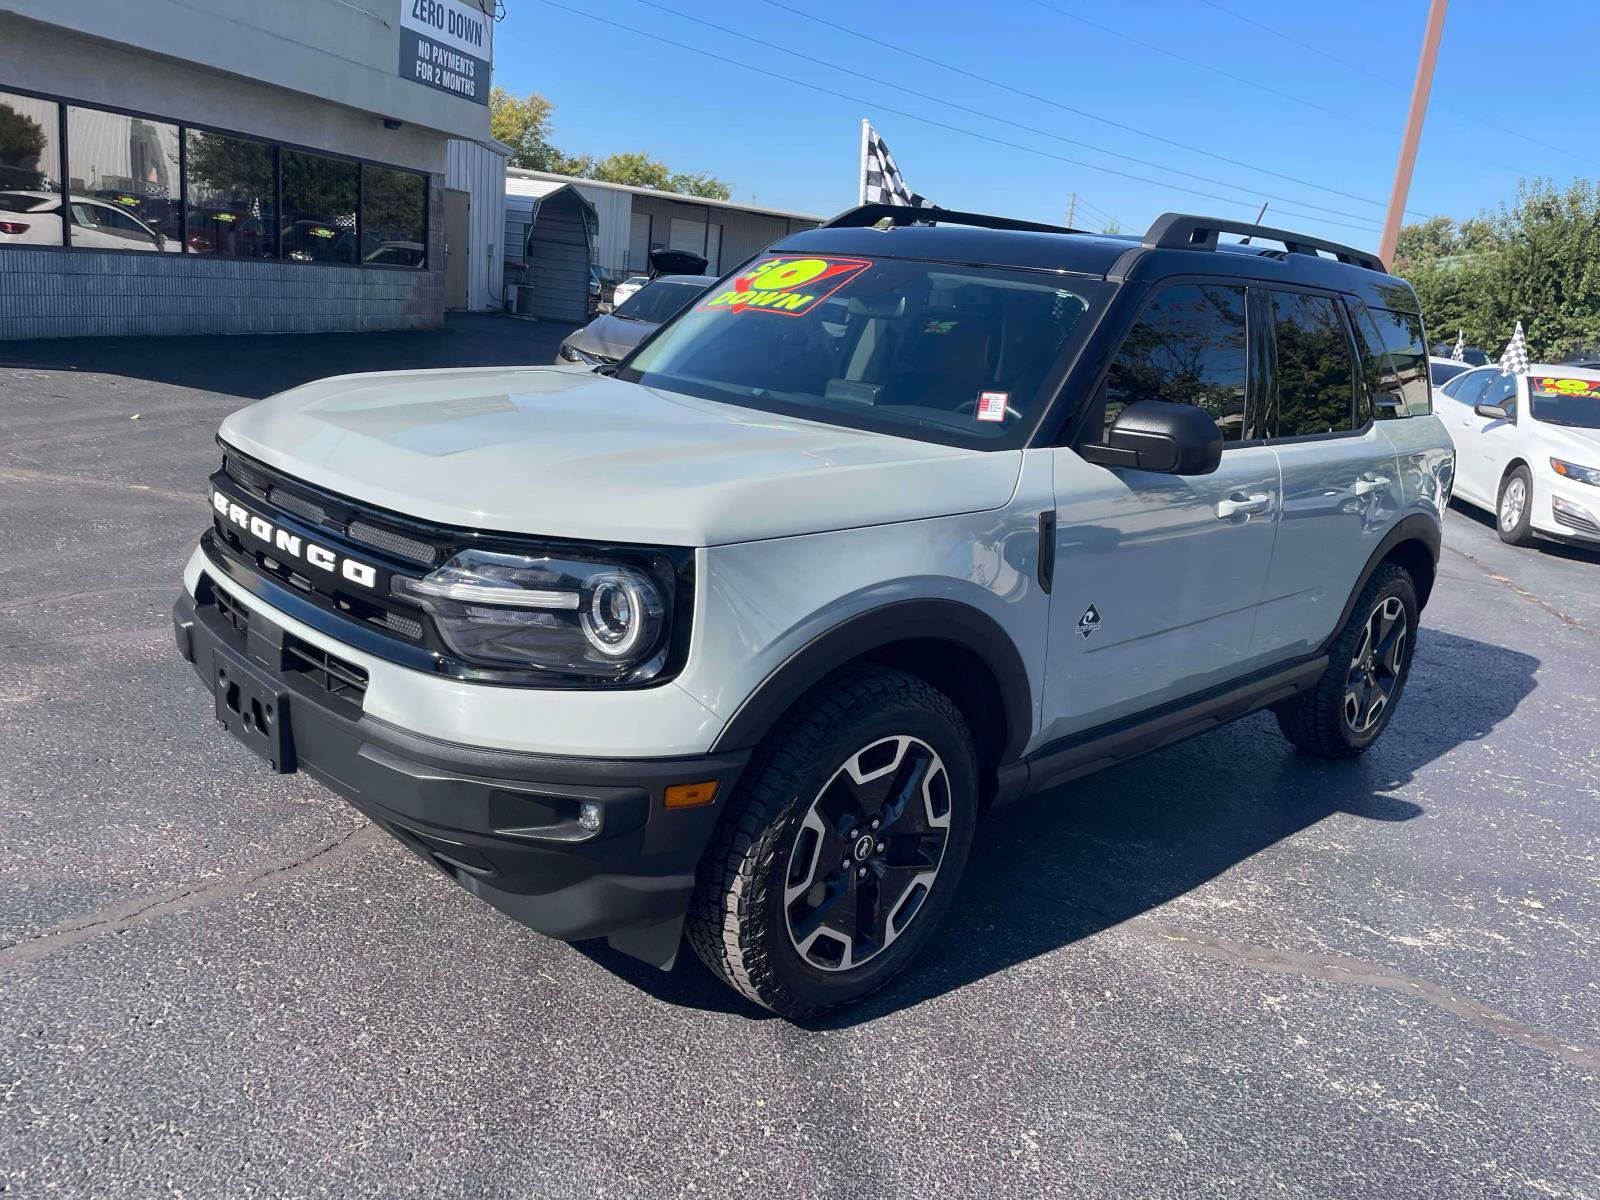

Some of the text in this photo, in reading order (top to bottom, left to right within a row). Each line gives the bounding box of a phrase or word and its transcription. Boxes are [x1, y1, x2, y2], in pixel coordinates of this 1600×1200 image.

[411, 0, 482, 47] ZERO DOWN
[418, 39, 475, 77] NO PAYMENTS
[415, 60, 475, 97] FOR 2 MONTHS
[707, 290, 815, 311] DOWN
[213, 491, 377, 588] BRONCO
